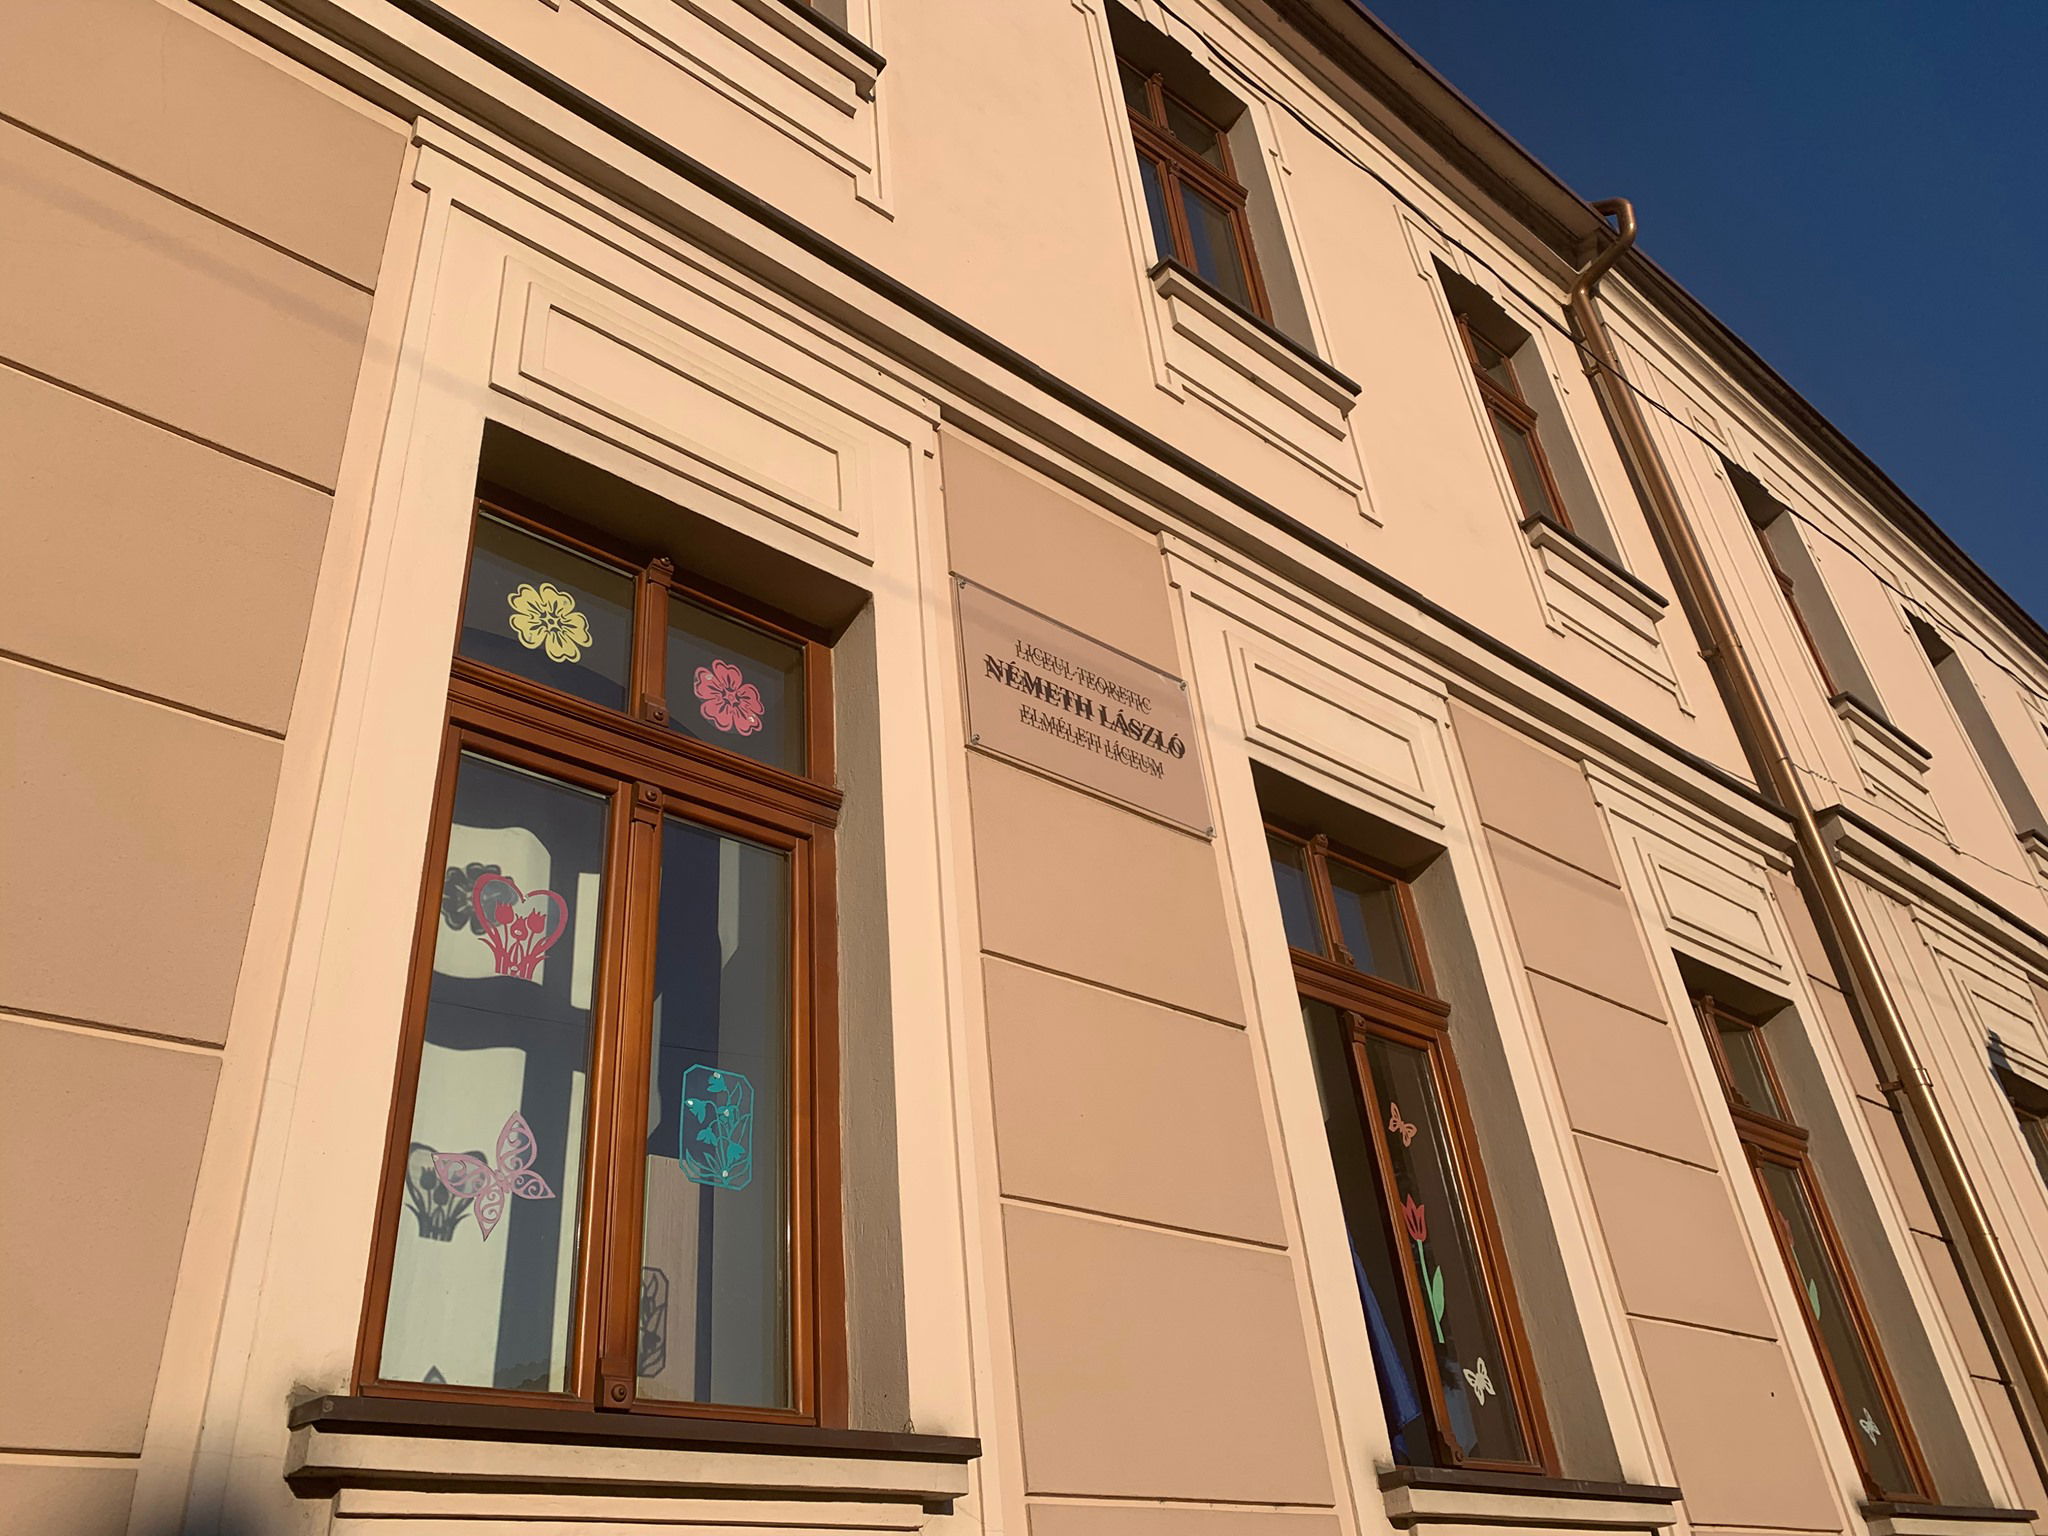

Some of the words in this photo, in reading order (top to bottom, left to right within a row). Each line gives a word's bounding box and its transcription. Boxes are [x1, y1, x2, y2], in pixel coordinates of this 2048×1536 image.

[984, 654, 1095, 721] NÉMETH
[1098, 703, 1185, 759] LÁSZLÓ
[1015, 640, 1074, 680] LICEUL
[1075, 667, 1152, 714] TEORETIC
[1020, 704, 1103, 753] ELMÉLETI
[1104, 738, 1164, 779] LÍCEUM
